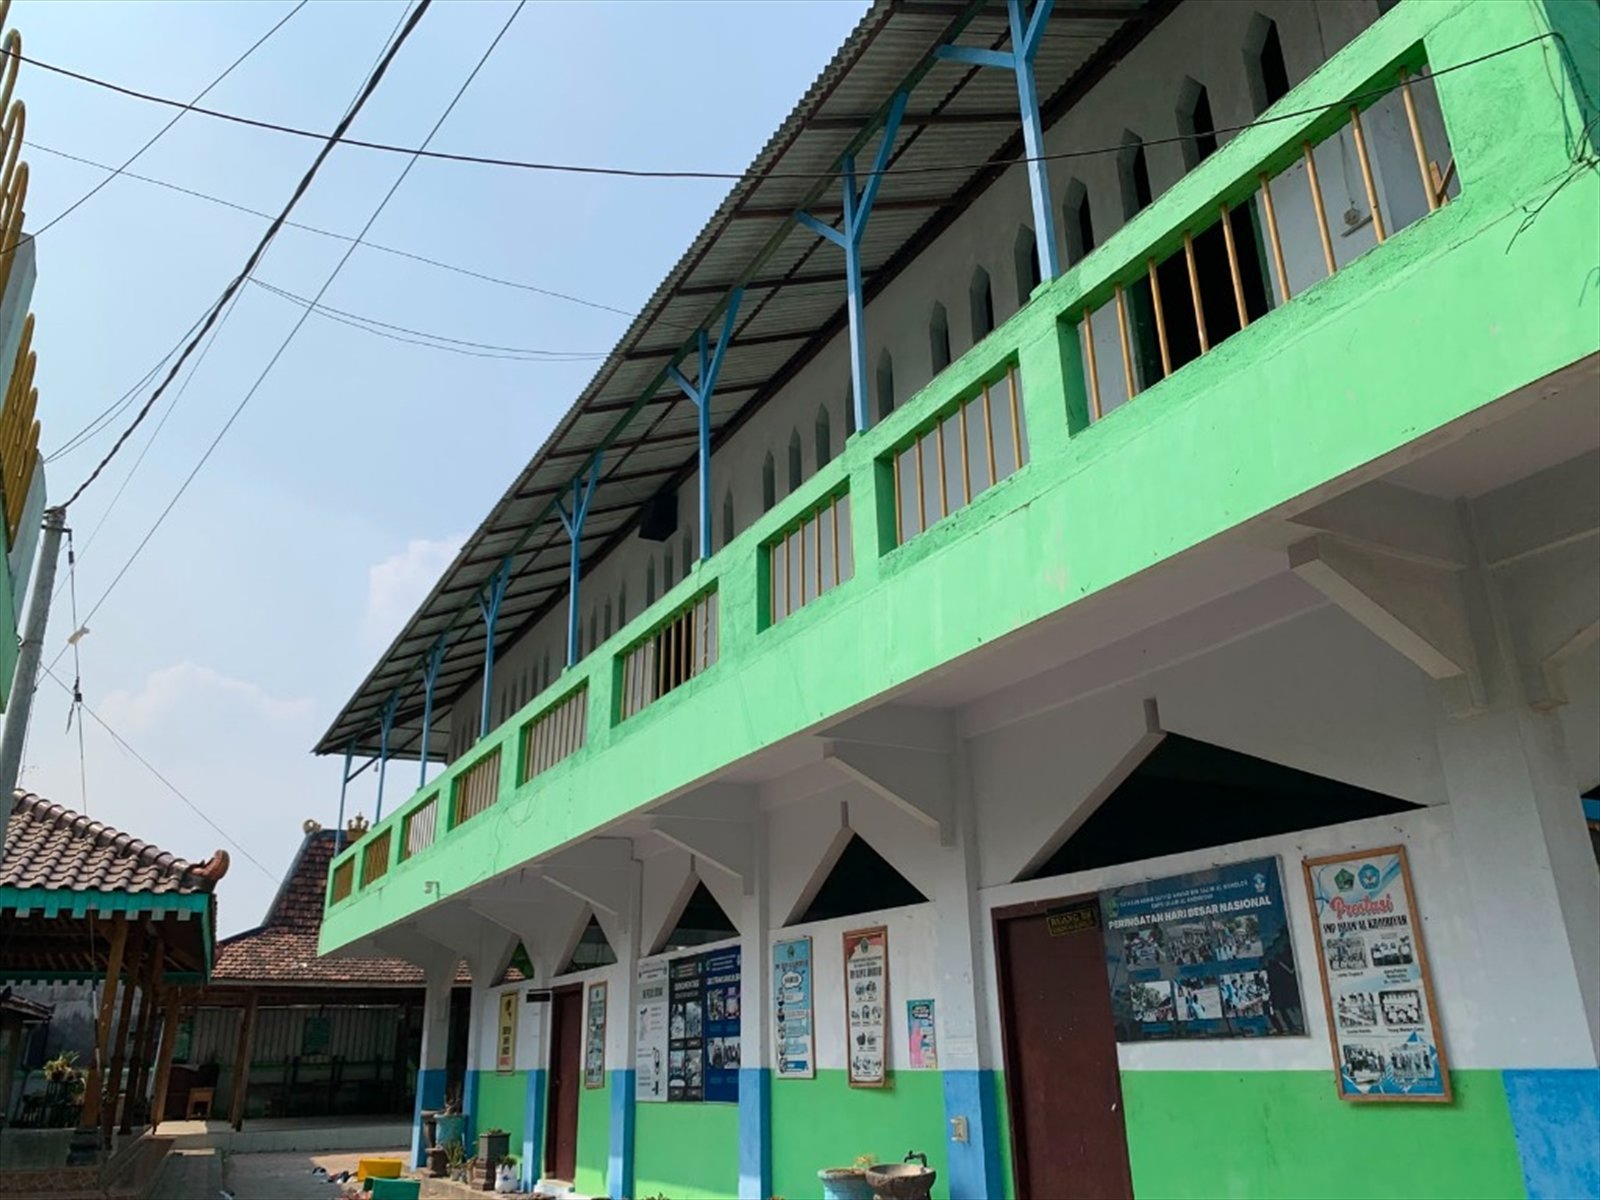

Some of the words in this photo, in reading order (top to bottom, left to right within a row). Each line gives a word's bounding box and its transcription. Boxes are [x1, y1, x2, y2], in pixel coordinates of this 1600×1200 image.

[1108, 915, 1164, 930] PERINGATAN
[1165, 910, 1187, 921] HARI
[1187, 905, 1219, 917] BESAR
[1219, 896, 1272, 912] NASIONAL
[1330, 894, 1393, 920] Prestasi
